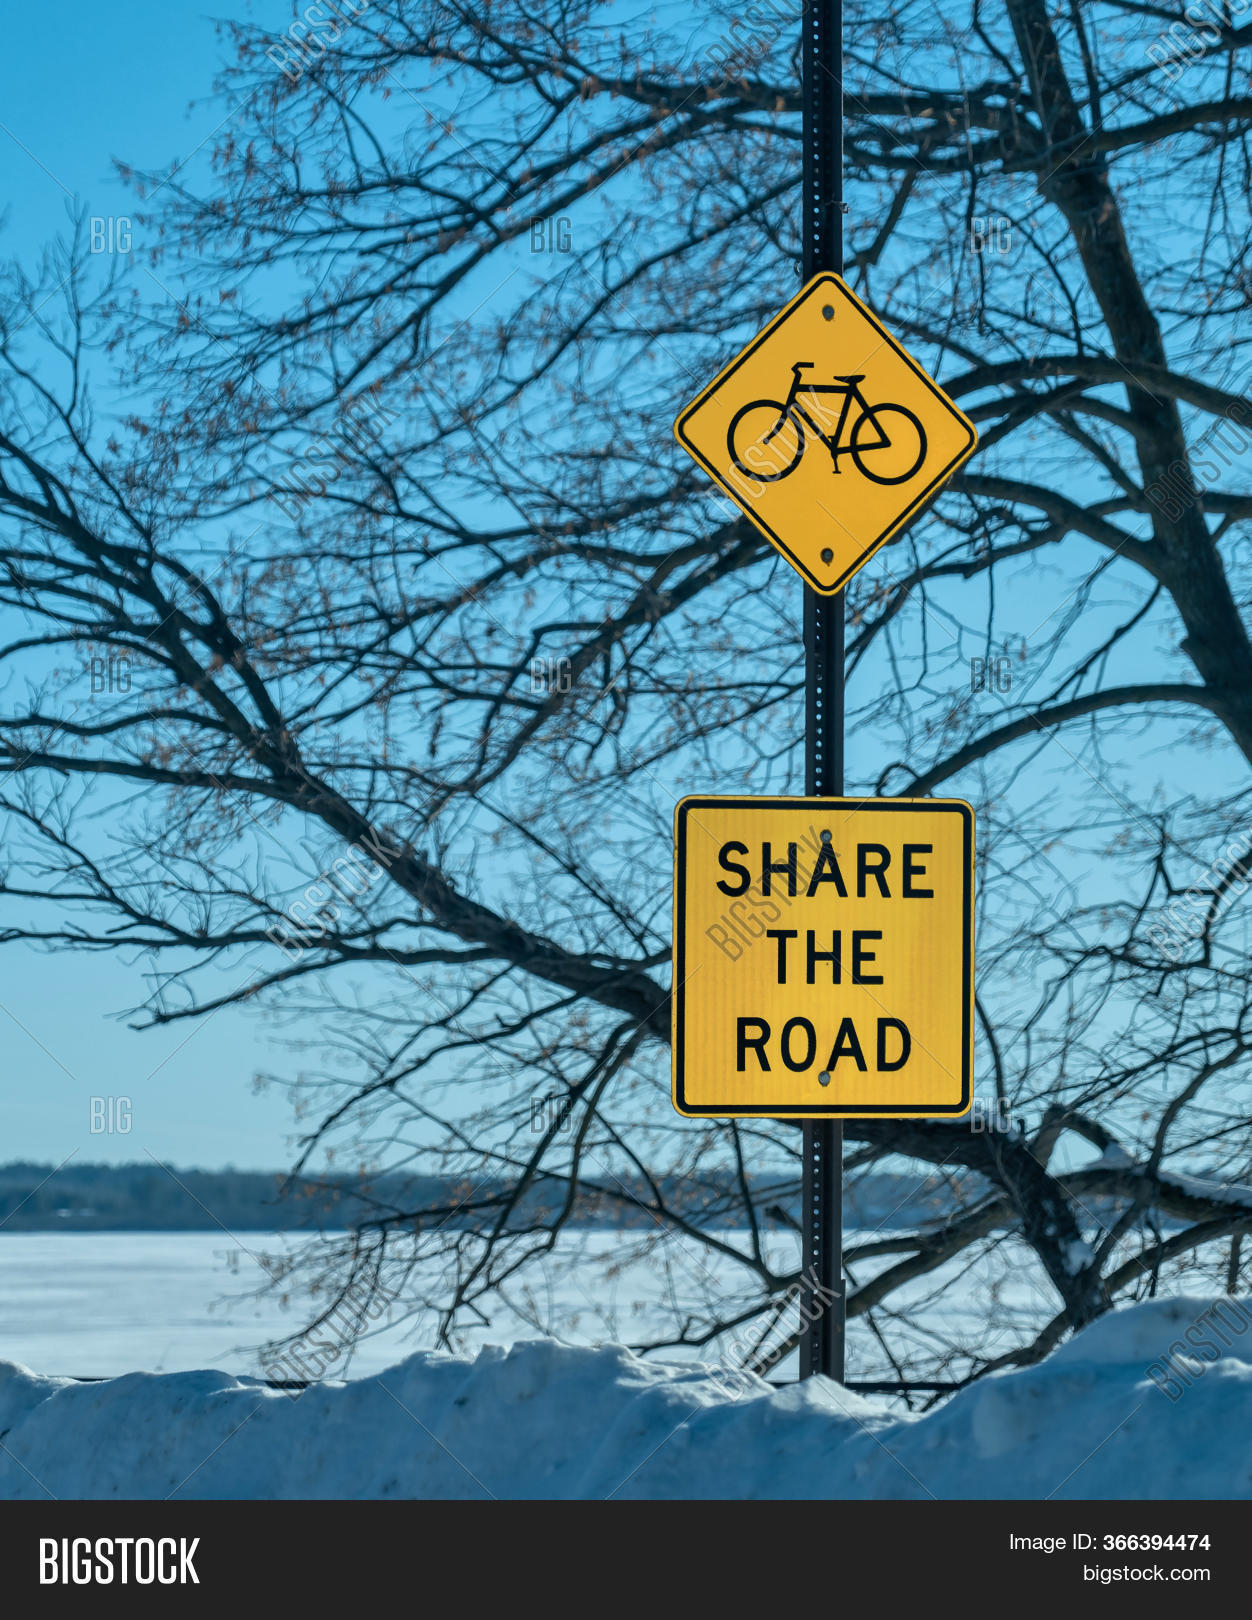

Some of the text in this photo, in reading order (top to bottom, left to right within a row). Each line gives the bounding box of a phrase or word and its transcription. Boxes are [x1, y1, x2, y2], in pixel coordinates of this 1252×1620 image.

[716, 841, 935, 899] SHARE
[766, 930, 884, 985] THE
[736, 1017, 911, 1072] ROAD
